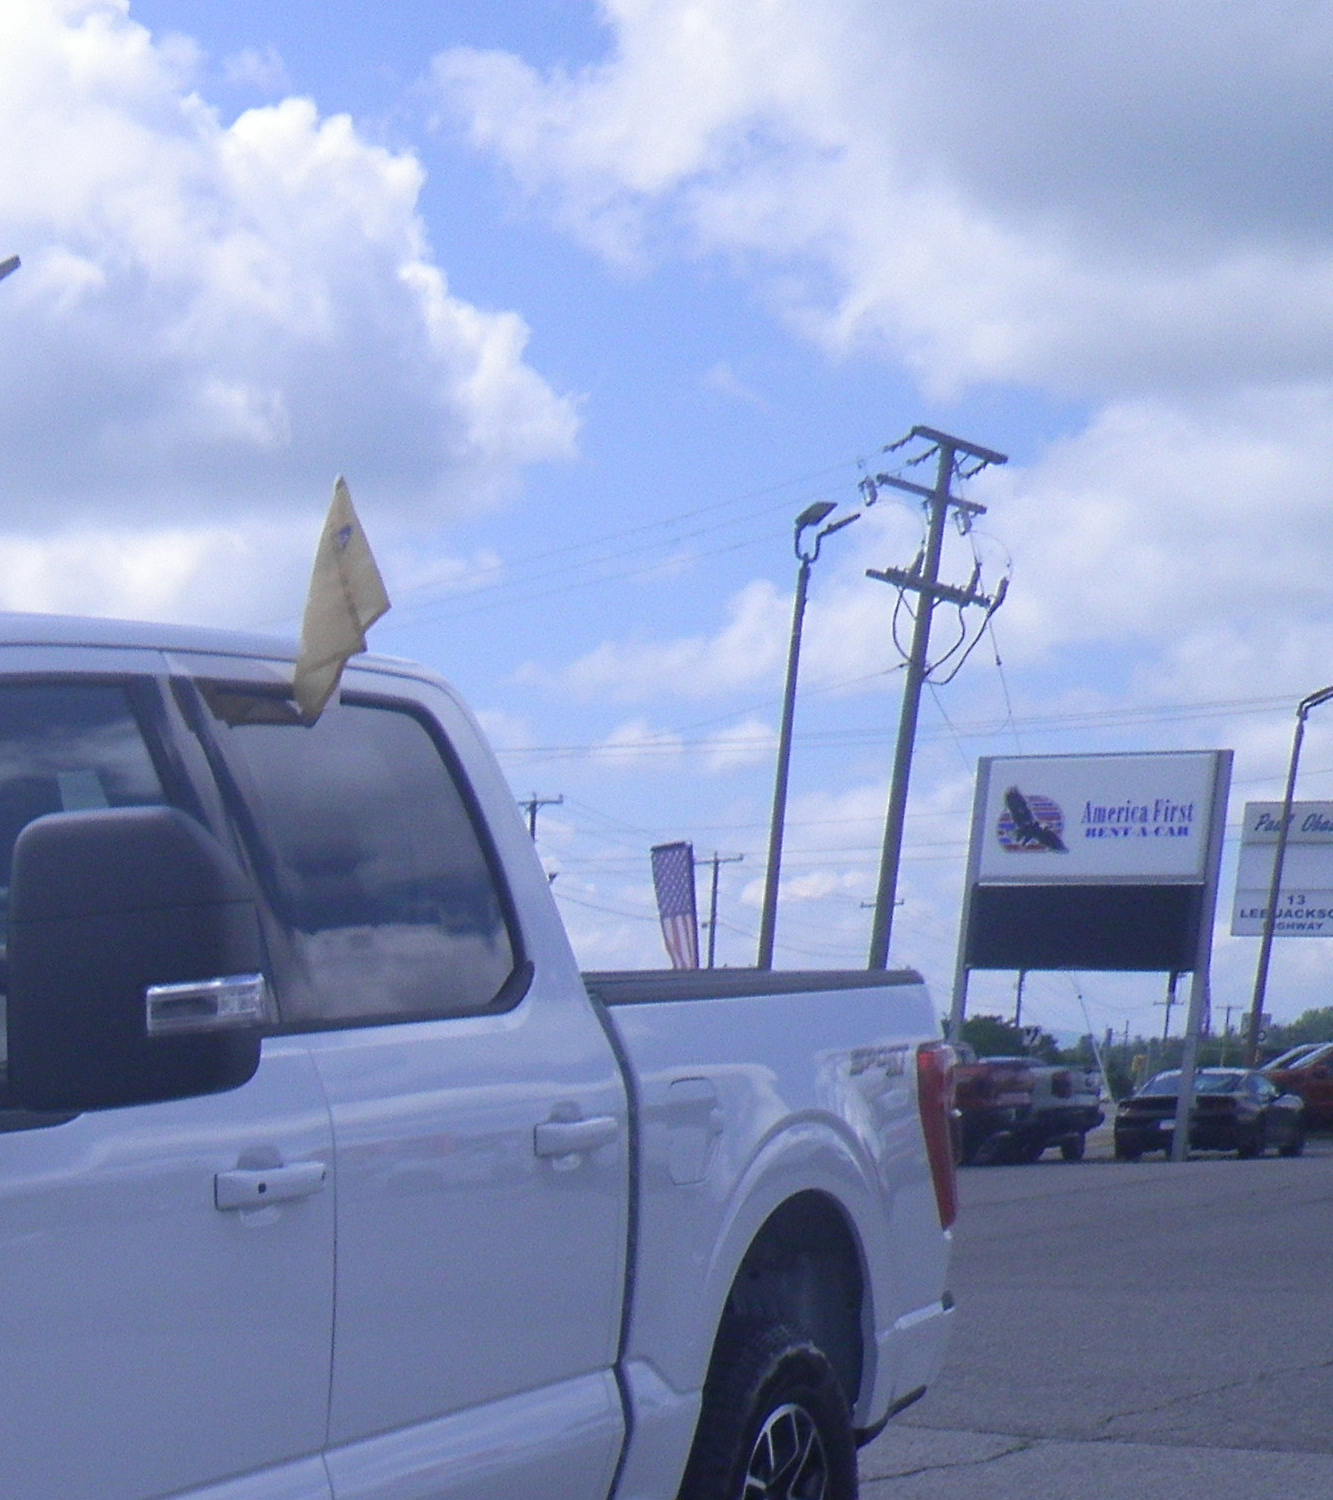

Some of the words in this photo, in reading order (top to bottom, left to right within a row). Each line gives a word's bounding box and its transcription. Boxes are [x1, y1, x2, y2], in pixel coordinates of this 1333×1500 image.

[1081, 800, 1148, 823] America
[1153, 798, 1194, 822] First
[1287, 894, 1306, 906] 13
[1263, 921, 1324, 931] GHWAY
